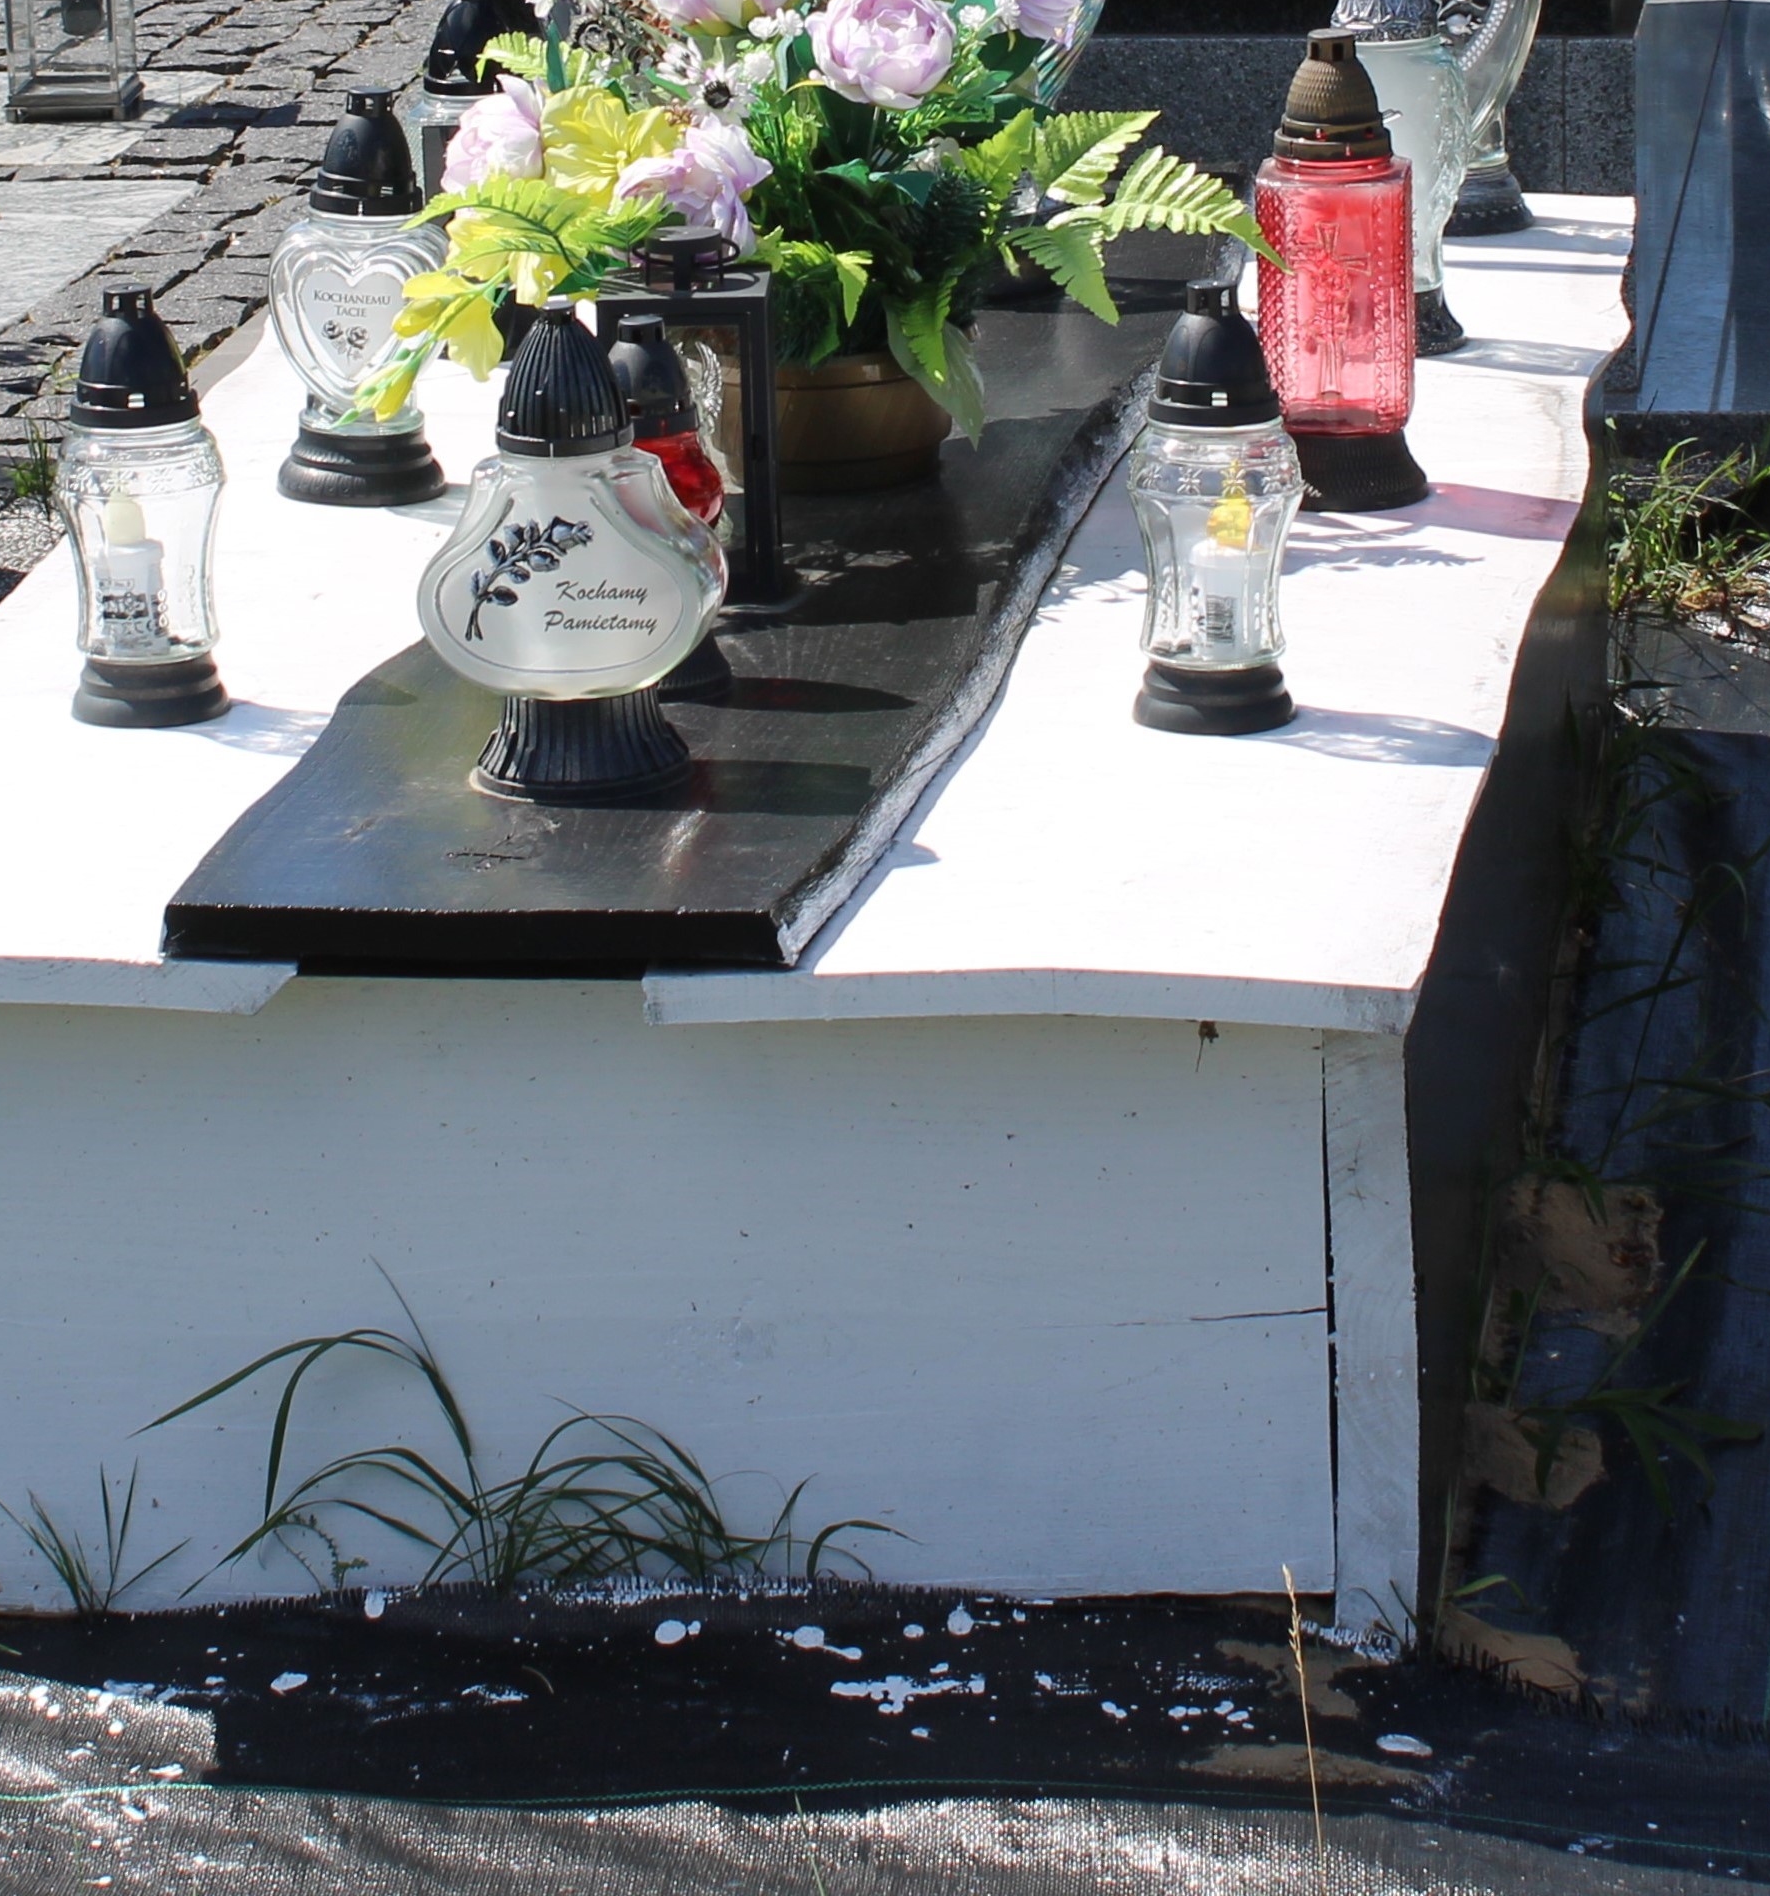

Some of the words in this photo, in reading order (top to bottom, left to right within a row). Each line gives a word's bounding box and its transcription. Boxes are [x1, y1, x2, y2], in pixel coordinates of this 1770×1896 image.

[313, 289, 391, 305] KOCHANEMU
[334, 305, 367, 317] TACIE
[555, 579, 648, 605] Kochamy
